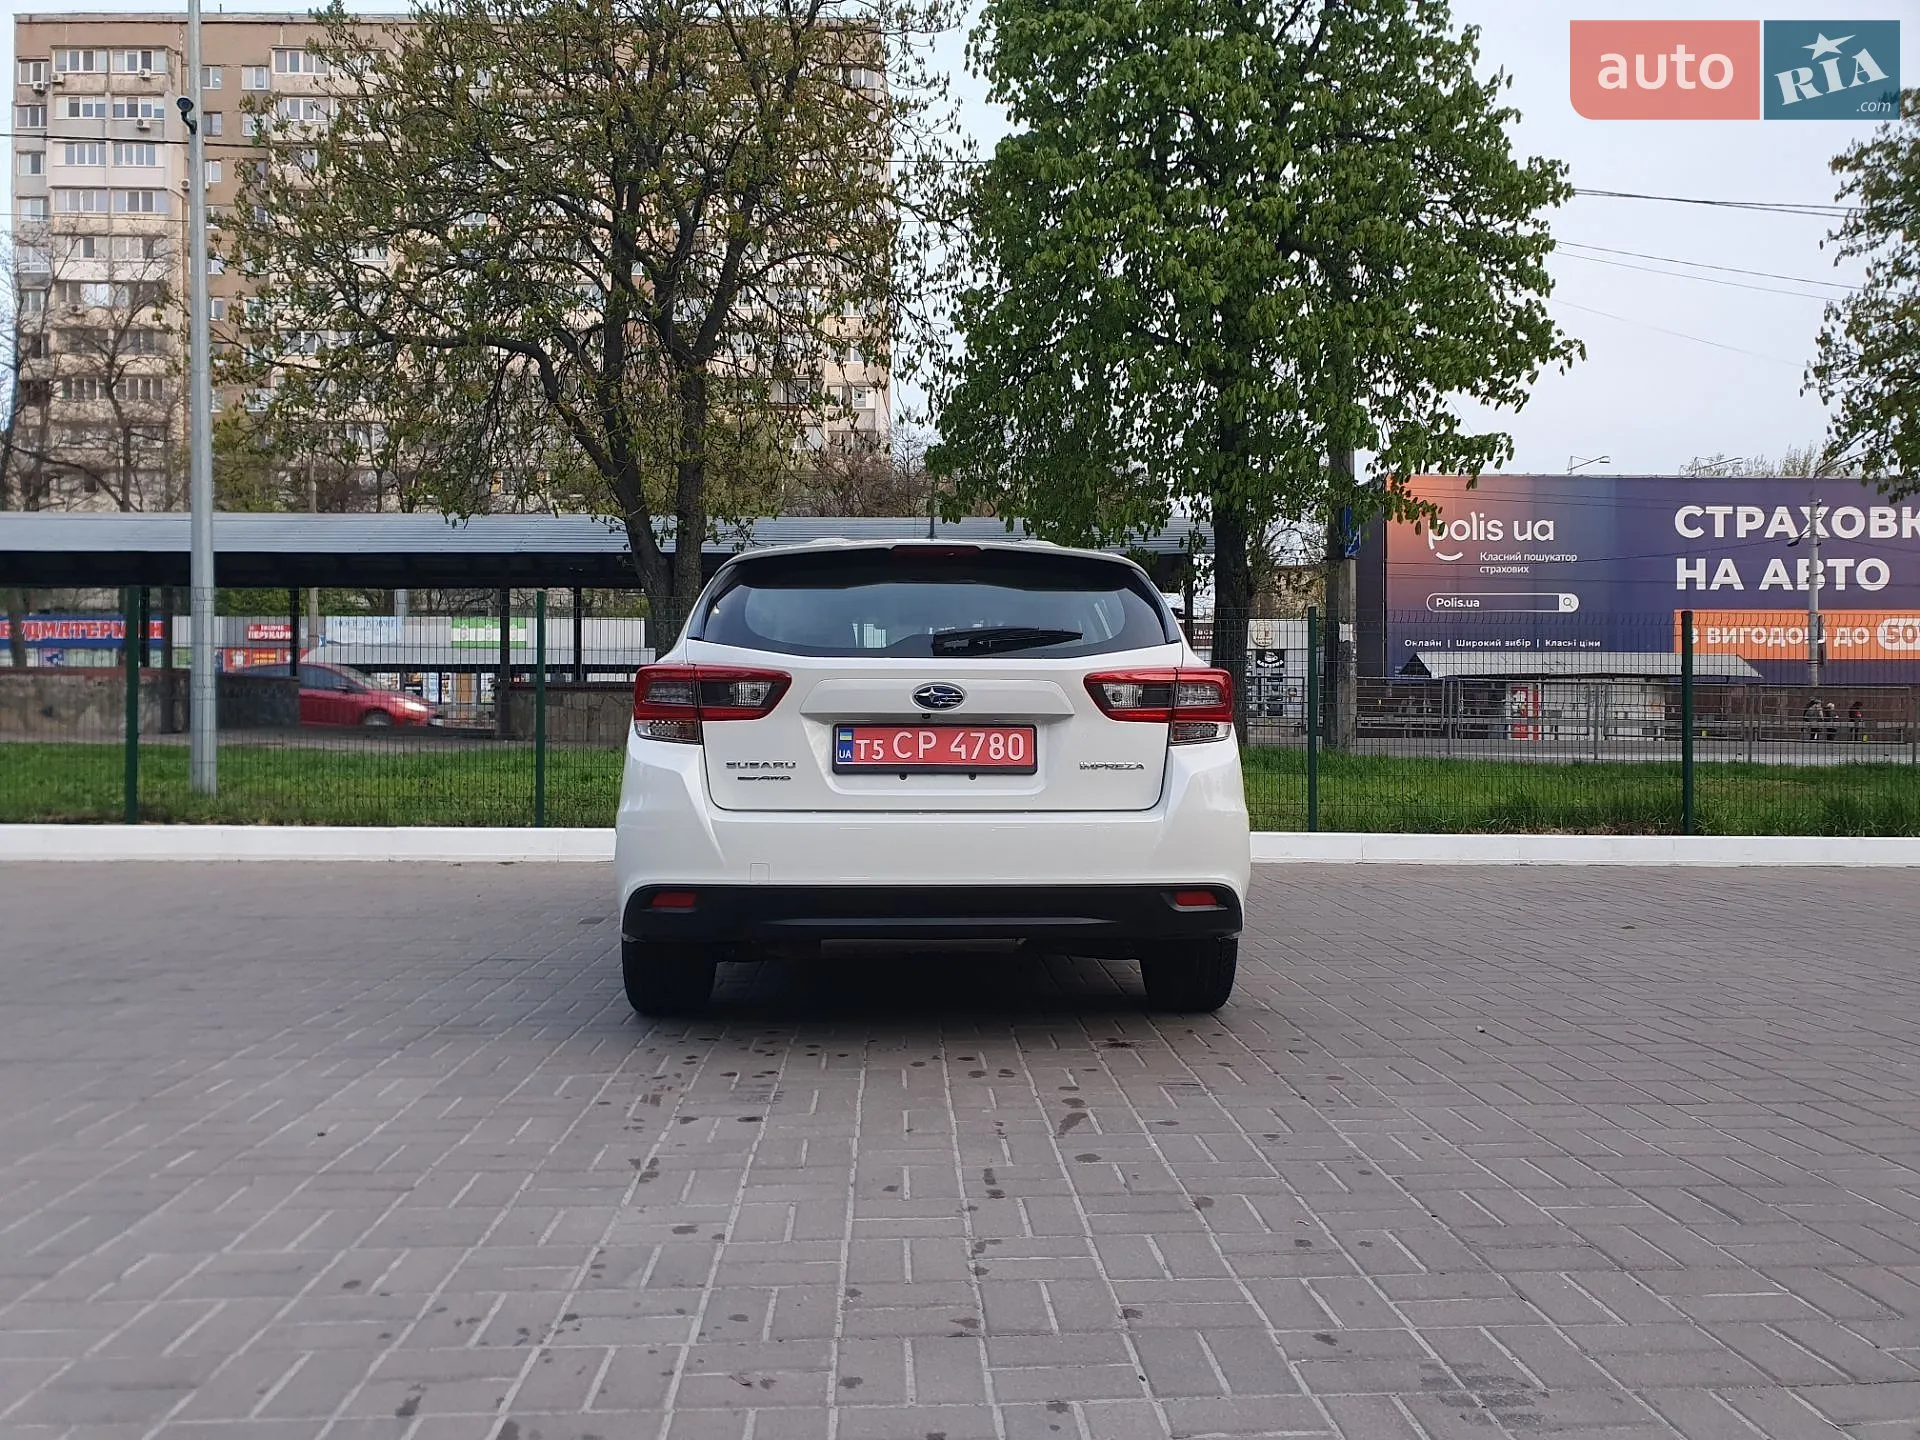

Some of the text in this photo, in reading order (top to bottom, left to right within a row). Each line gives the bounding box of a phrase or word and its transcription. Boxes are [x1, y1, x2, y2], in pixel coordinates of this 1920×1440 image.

[1674, 505, 1920, 539] СТРАХОВК
[1427, 511, 1555, 550] polis ua
[1480, 551, 1578, 564] Класний пошукатор
[1479, 565, 1529, 574] страхових
[1676, 558, 1890, 591] НА АВТО
[1436, 598, 1480, 608] Polis.ua
[1404, 638, 1601, 648] Онлайн Широкий вибір Класні ціни
[1833, 627, 1870, 647] ДО
[839, 731, 1025, 761] UA T5 CP 4780
[725, 760, 797, 769] SUBARU
[1079, 761, 1145, 770] IMPREZA
